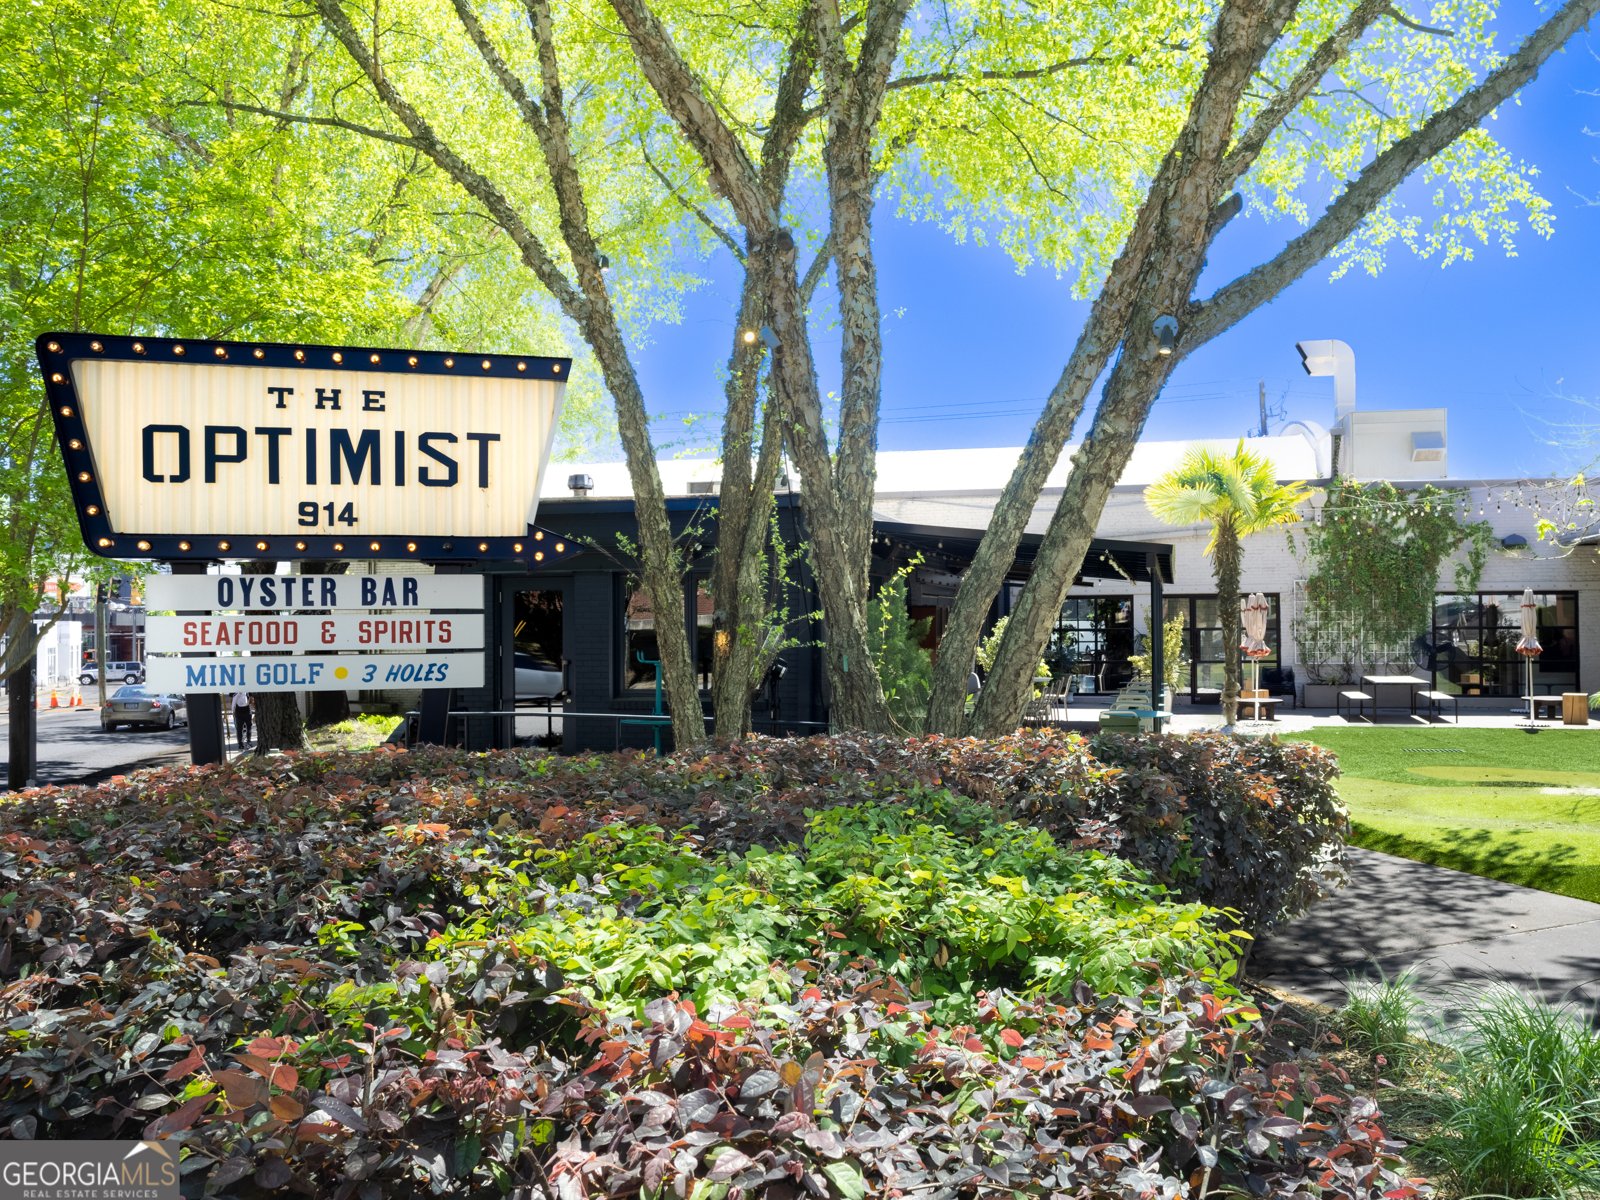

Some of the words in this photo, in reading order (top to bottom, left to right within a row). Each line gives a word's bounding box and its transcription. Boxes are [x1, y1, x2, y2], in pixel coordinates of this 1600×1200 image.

[267, 387, 386, 412] THE
[142, 424, 501, 488] OPTIMIST
[297, 501, 359, 527] 914
[217, 576, 337, 607] OYSTER
[361, 576, 419, 606] BAR
[183, 621, 299, 646] SEAFOOD
[321, 621, 337, 645] &
[358, 620, 453, 644] SPIRITS
[185, 664, 246, 688] MINI
[256, 662, 325, 686] GOLF
[361, 663, 376, 684] 3
[385, 663, 449, 683] HOLES
